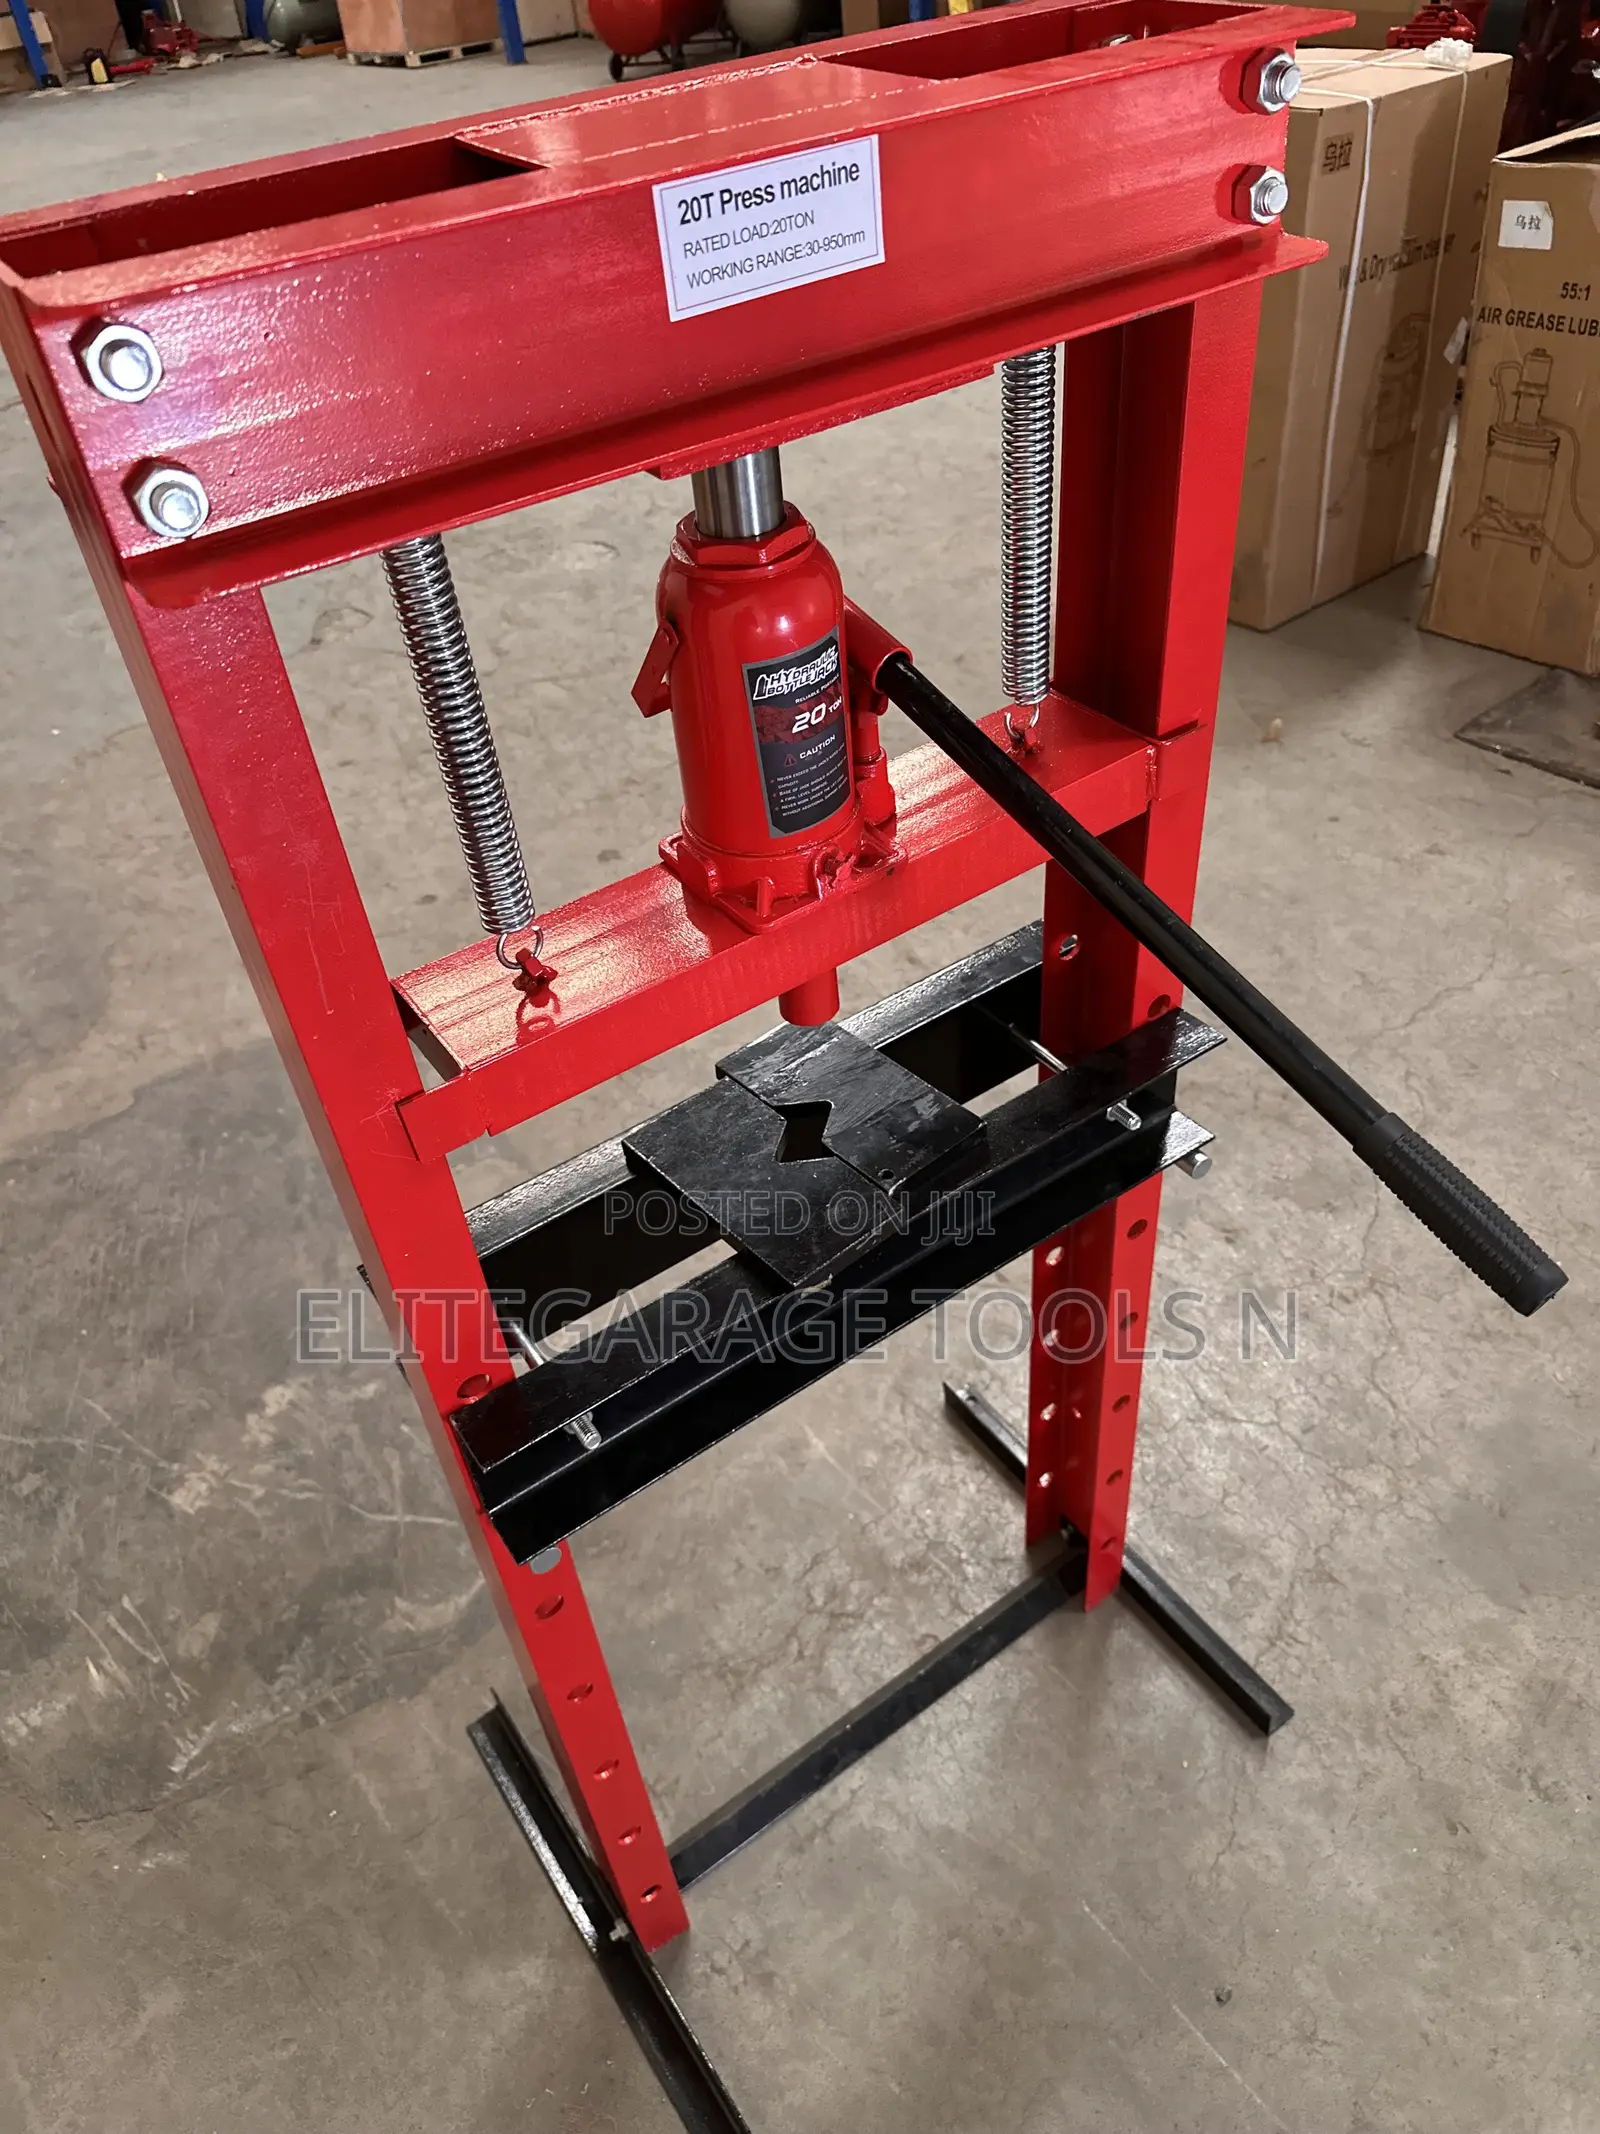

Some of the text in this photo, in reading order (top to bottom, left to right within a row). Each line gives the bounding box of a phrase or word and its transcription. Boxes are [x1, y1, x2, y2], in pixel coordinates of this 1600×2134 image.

[678, 162, 860, 225] 20T Press machine
[683, 233, 731, 259] RATED
[687, 259, 754, 289] WORKING
[1560, 282, 1591, 301] 55:1
[1477, 306, 1600, 337] AIR GREASE LUB
[792, 696, 842, 733] 20 TON
[800, 734, 836, 759] CAUTION
